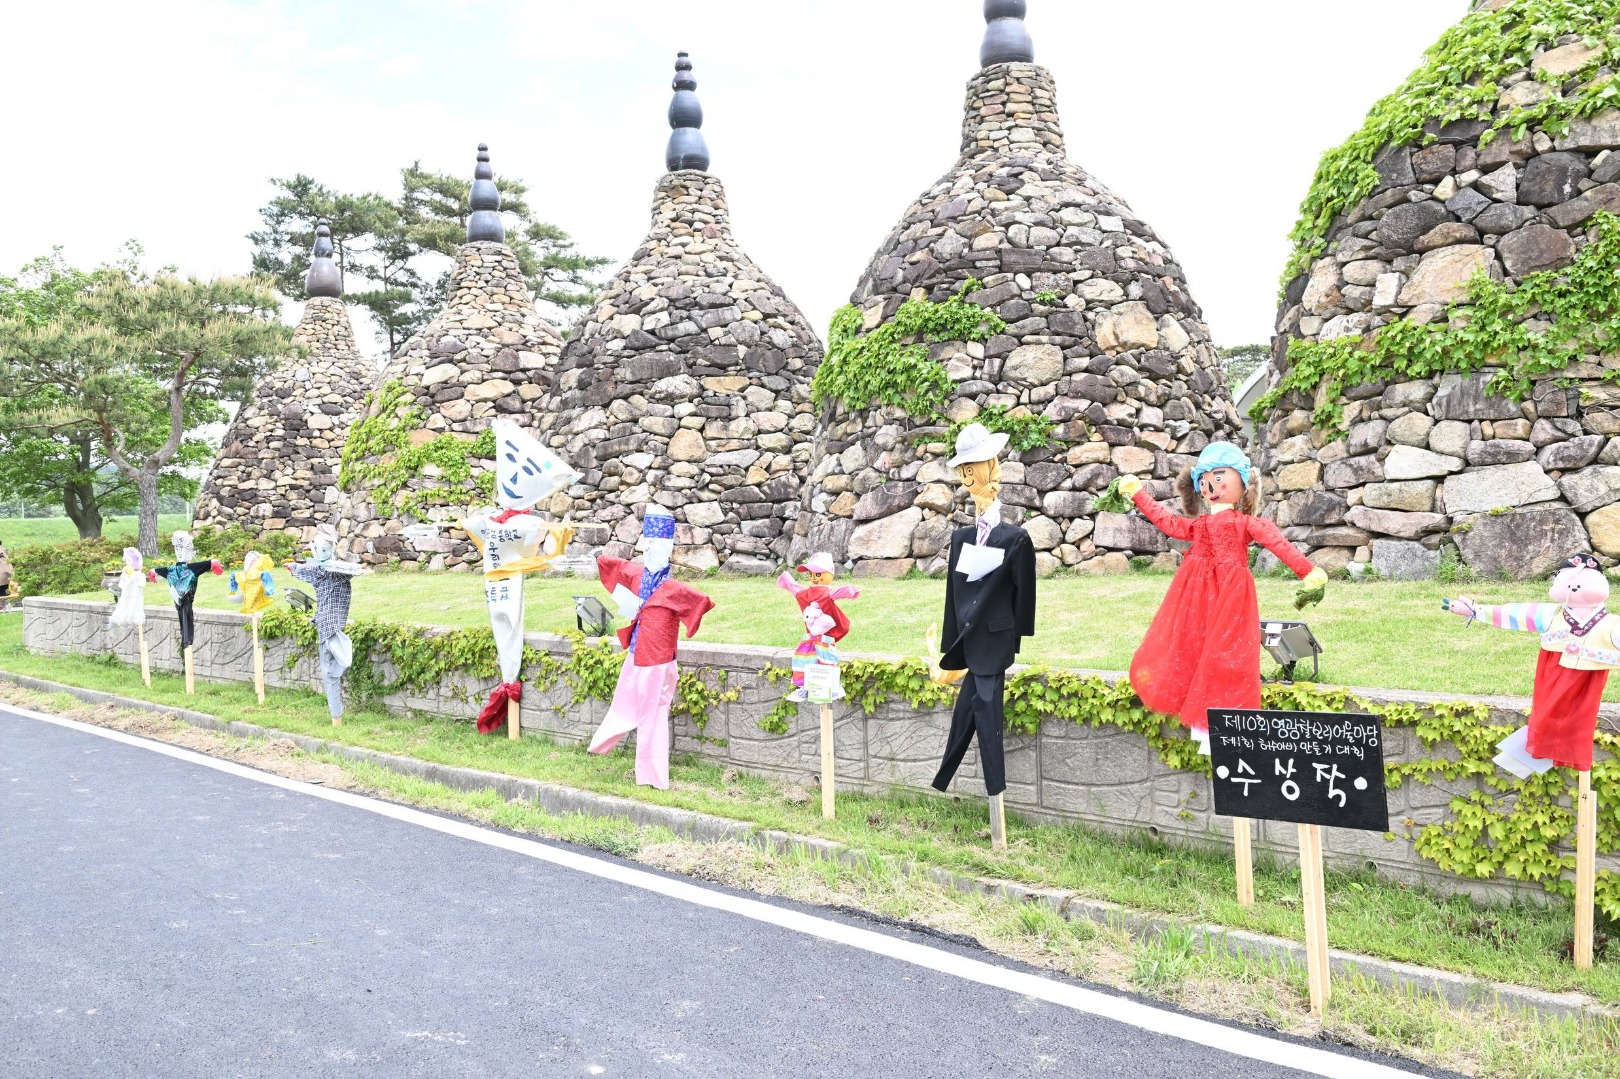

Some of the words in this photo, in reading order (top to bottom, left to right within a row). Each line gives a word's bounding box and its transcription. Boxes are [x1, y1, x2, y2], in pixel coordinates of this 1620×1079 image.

[1220, 735, 1254, 750] 제1회
[1258, 737, 1298, 752] 허수아비
[1299, 740, 1332, 755] 만들기
[1335, 745, 1364, 760] 대회
